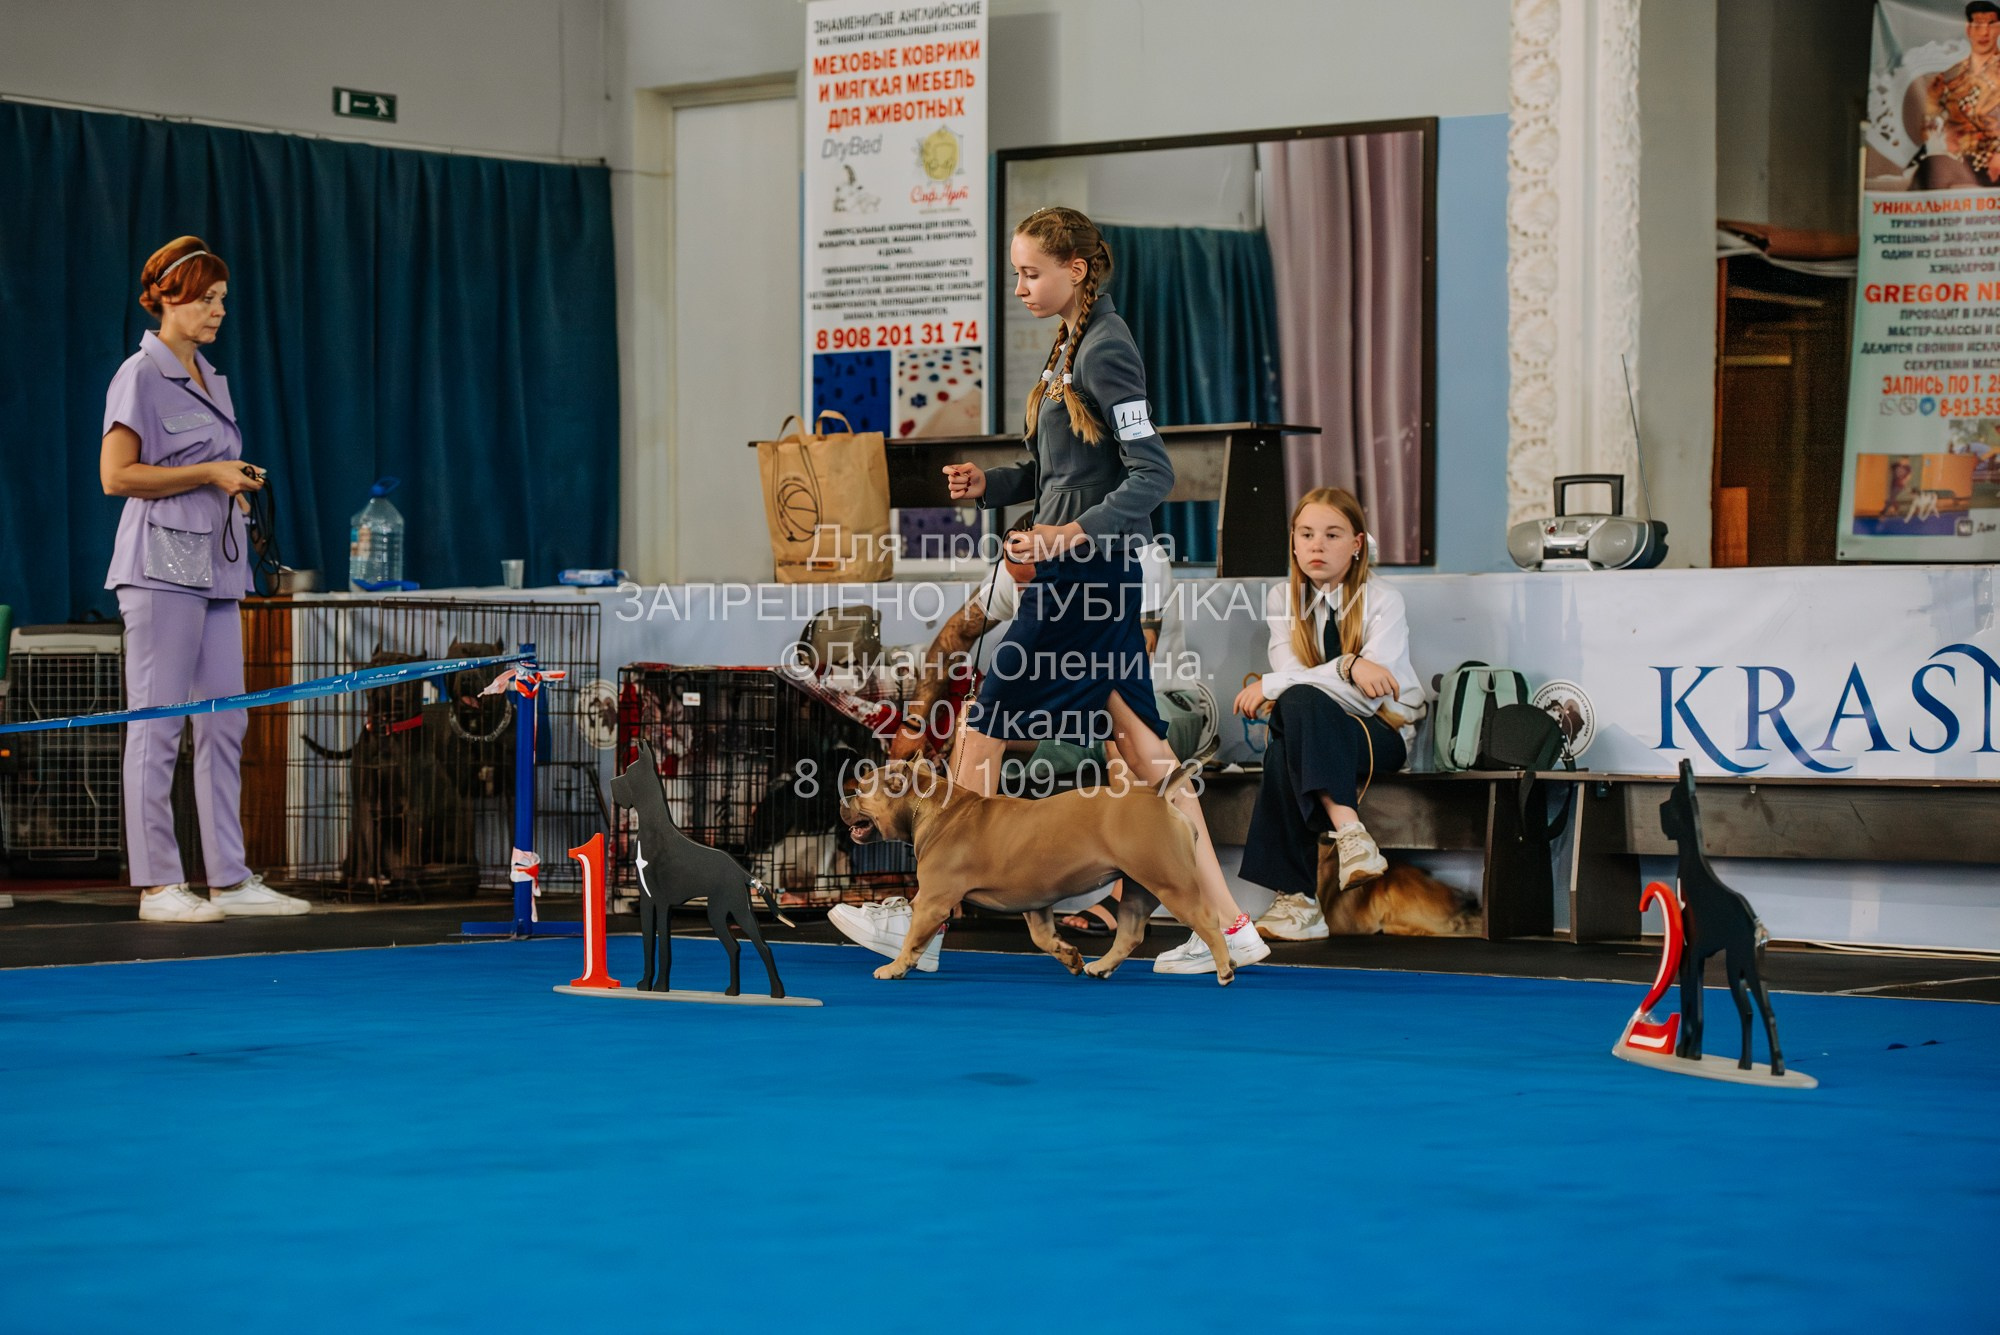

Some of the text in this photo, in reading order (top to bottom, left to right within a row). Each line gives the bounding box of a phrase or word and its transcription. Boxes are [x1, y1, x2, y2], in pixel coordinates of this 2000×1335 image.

[814, 1, 982, 34] ЗНАМЕНИТЫЕ АНГЛИЙСКИЕ
[813, 39, 981, 76] МЕХОВЫЕ КОВРИКИ
[818, 68, 976, 103] И МЯГКАЯ МЕБЕЛЬ
[828, 96, 966, 132] ДЛЯ ЖИВОТНЫХ
[821, 134, 883, 161] DryBed
[1872, 196, 1972, 215] УНИКАЛЬНАЯ
[1873, 231, 1940, 244] УСПЕШНЫЙ
[1881, 250, 1913, 260] ОДИН
[1916, 249, 1931, 259] ИЗ
[1934, 248, 1973, 259] САМЫХ
[1929, 262, 1995, 274] ХЭНДЛЕРОВ
[1864, 282, 1970, 304] GREGOR
[1900, 308, 1959, 320] ПРОВОДИТ
[1963, 308, 1970, 319] В
[816, 321, 978, 350] 8 908 201 31 74
[1888, 324, 1982, 337] МАСТЕР-КЛАССЫ
[1985, 324, 1993, 335] И
[1861, 342, 1913, 354] ДЕЛИТСЯ
[1916, 341, 1964, 352] СВОИМИ
[1904, 359, 1969, 371] СЕКРЕТАМИ
[1882, 374, 2000, 395] ЗАПИСЬ ПО Т. 2
[568, 832, 621, 988] 1
